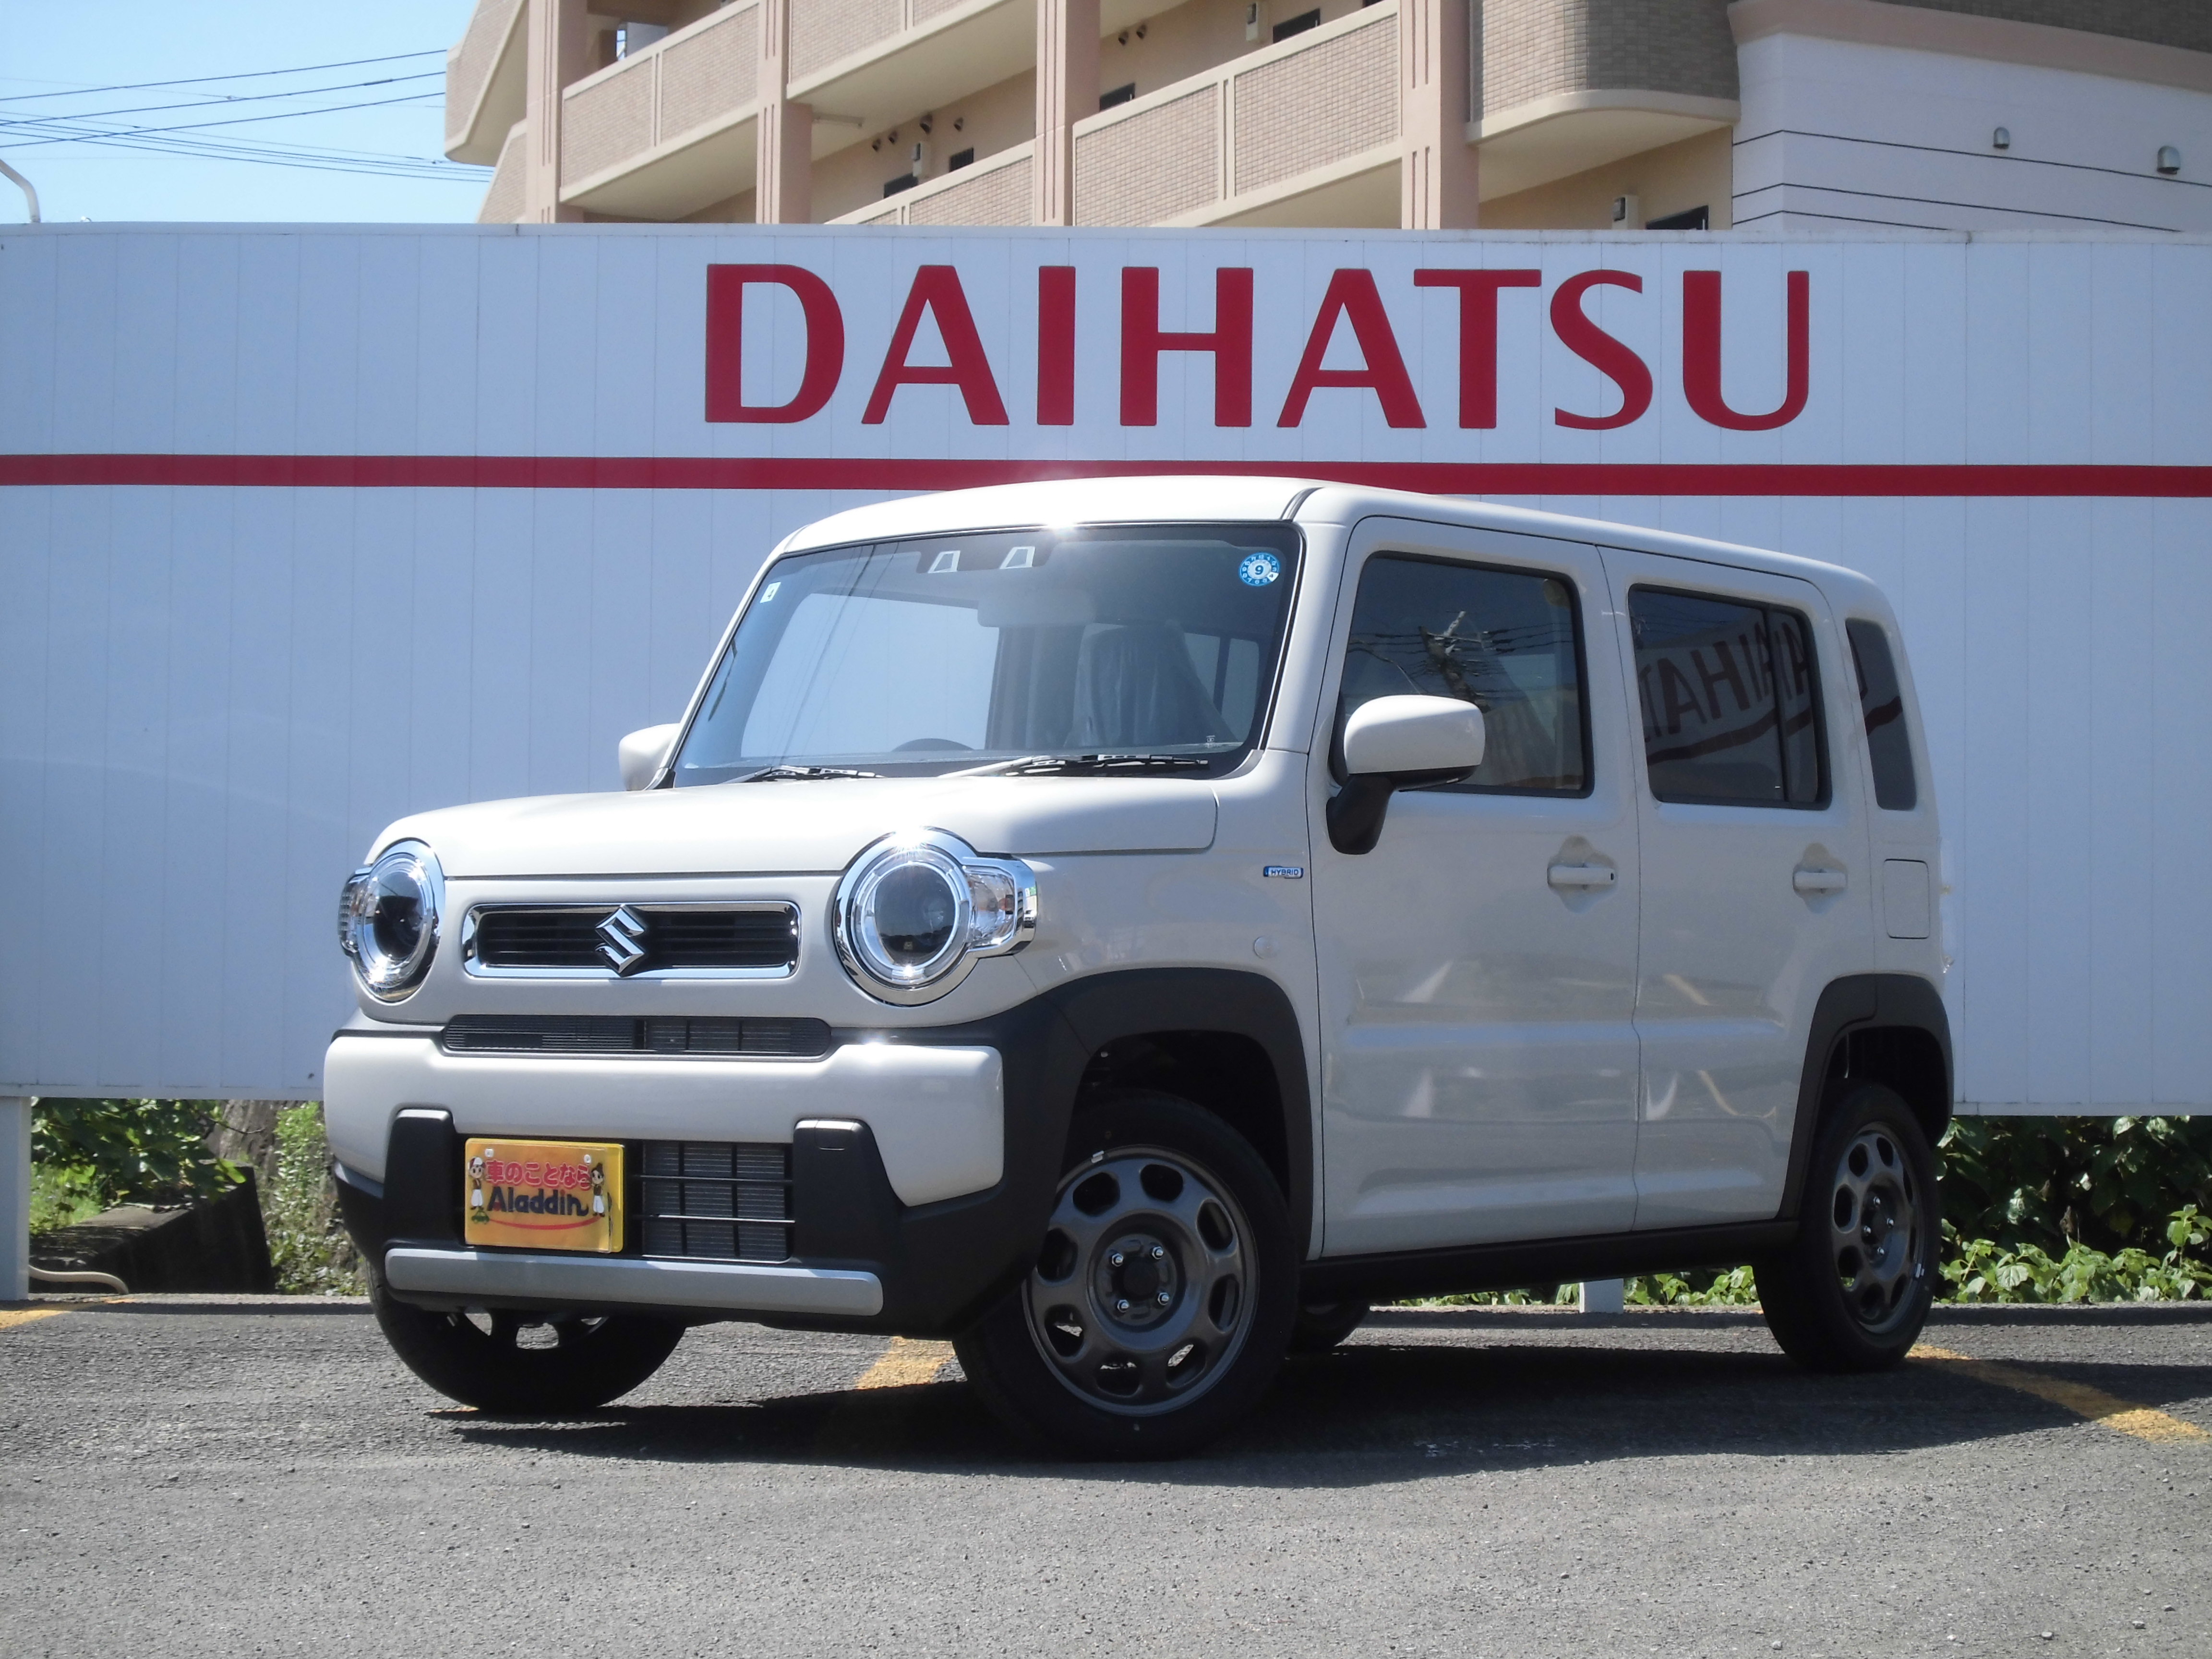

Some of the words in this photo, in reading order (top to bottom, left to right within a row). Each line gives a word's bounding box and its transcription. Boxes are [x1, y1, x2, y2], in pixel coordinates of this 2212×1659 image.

[707, 264, 1809, 431] DAIHATSU
[1255, 565, 1263, 575] 9
[485, 1159, 592, 1190] 車のことなら
[487, 1186, 589, 1216] Aladdin
